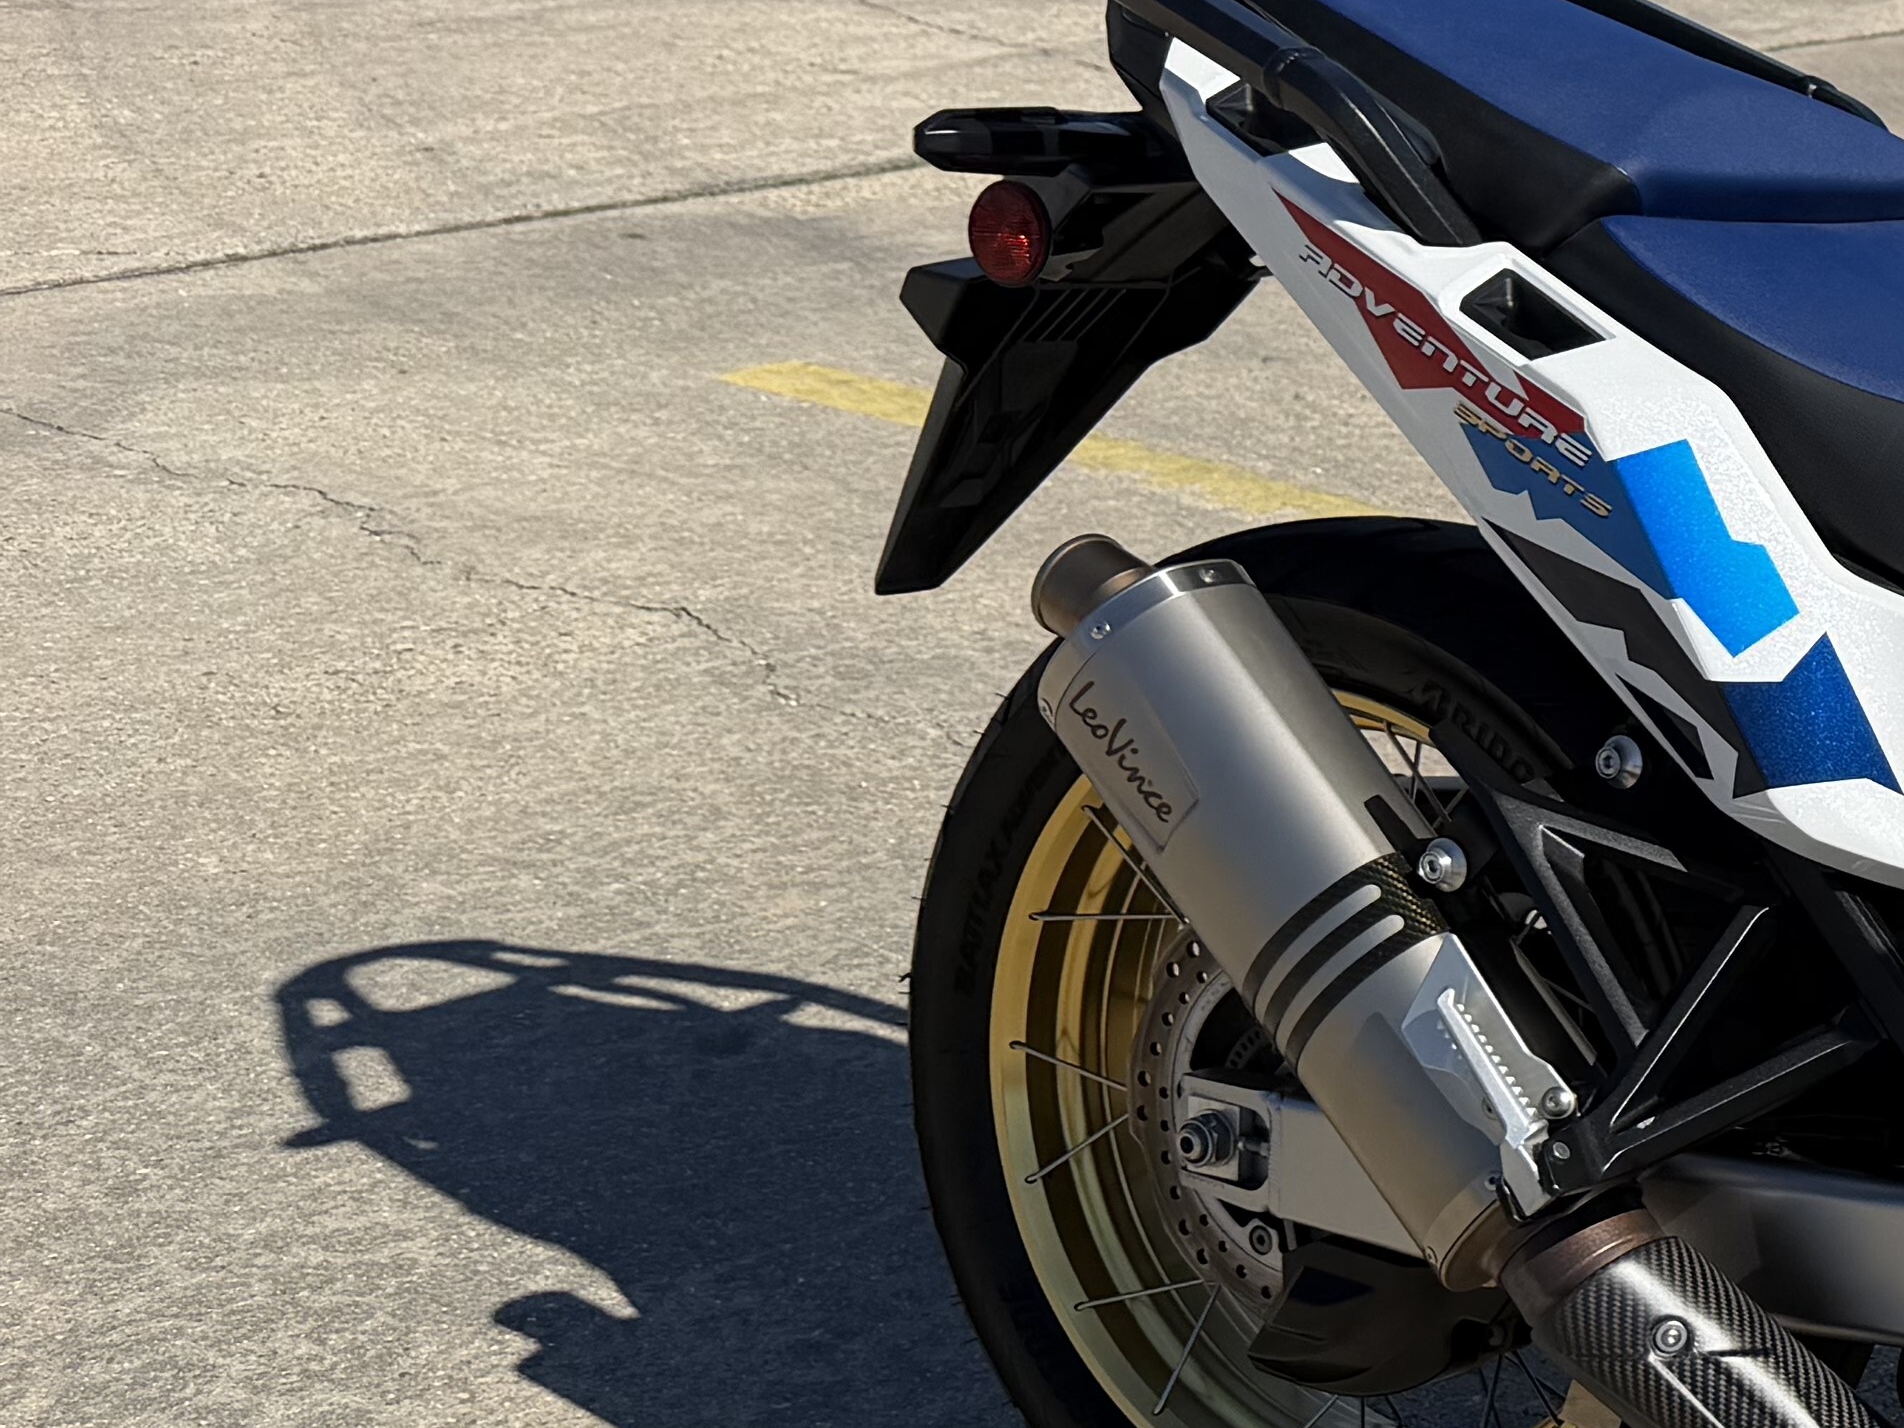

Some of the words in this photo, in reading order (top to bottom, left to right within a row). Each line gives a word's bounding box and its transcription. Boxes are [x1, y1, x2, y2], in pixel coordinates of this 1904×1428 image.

[1298, 244, 1593, 467] ADVENTURE
[1453, 400, 1613, 518] SPORTS
[1069, 681, 1172, 823] LeoVince
